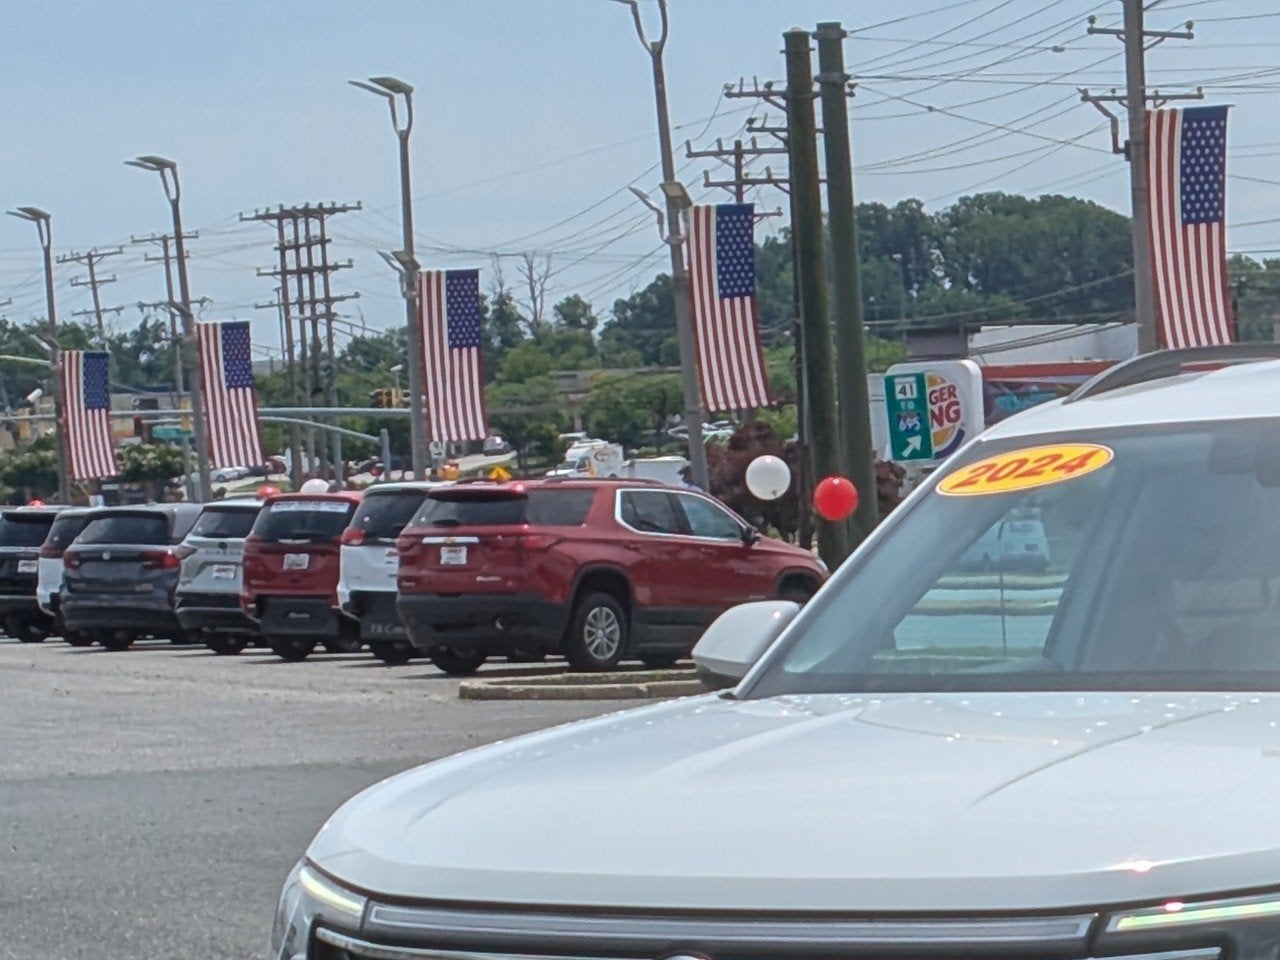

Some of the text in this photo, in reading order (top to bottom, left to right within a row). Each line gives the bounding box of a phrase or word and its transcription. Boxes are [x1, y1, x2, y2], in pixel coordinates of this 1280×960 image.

[899, 383, 914, 396] 41
[928, 384, 957, 405] GER
[930, 400, 961, 428] NG
[949, 449, 1100, 491] 2024
